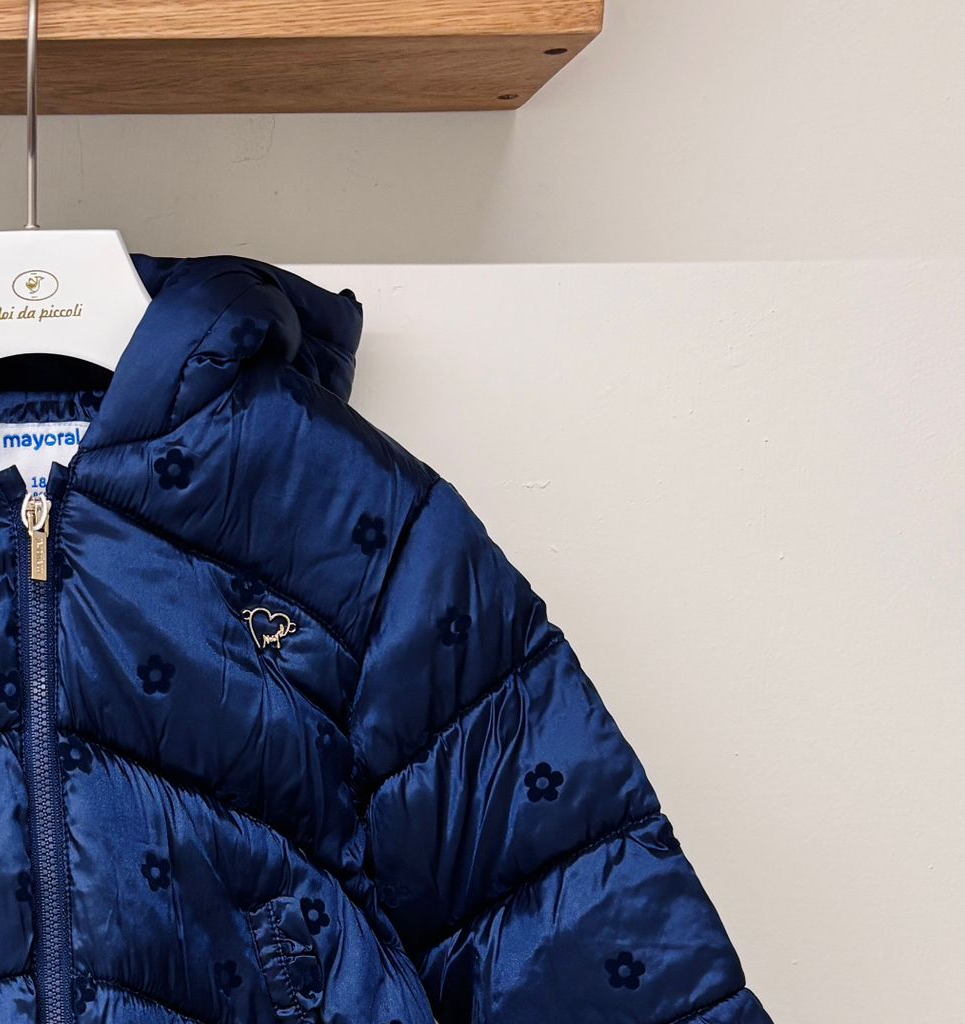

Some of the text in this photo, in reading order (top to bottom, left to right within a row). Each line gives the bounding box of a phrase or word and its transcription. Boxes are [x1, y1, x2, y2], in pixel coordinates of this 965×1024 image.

[16, 305, 36, 320] da
[38, 303, 83, 322] piccoli
[3, 428, 80, 450] mayoral
[31, 476, 47, 488] 18
